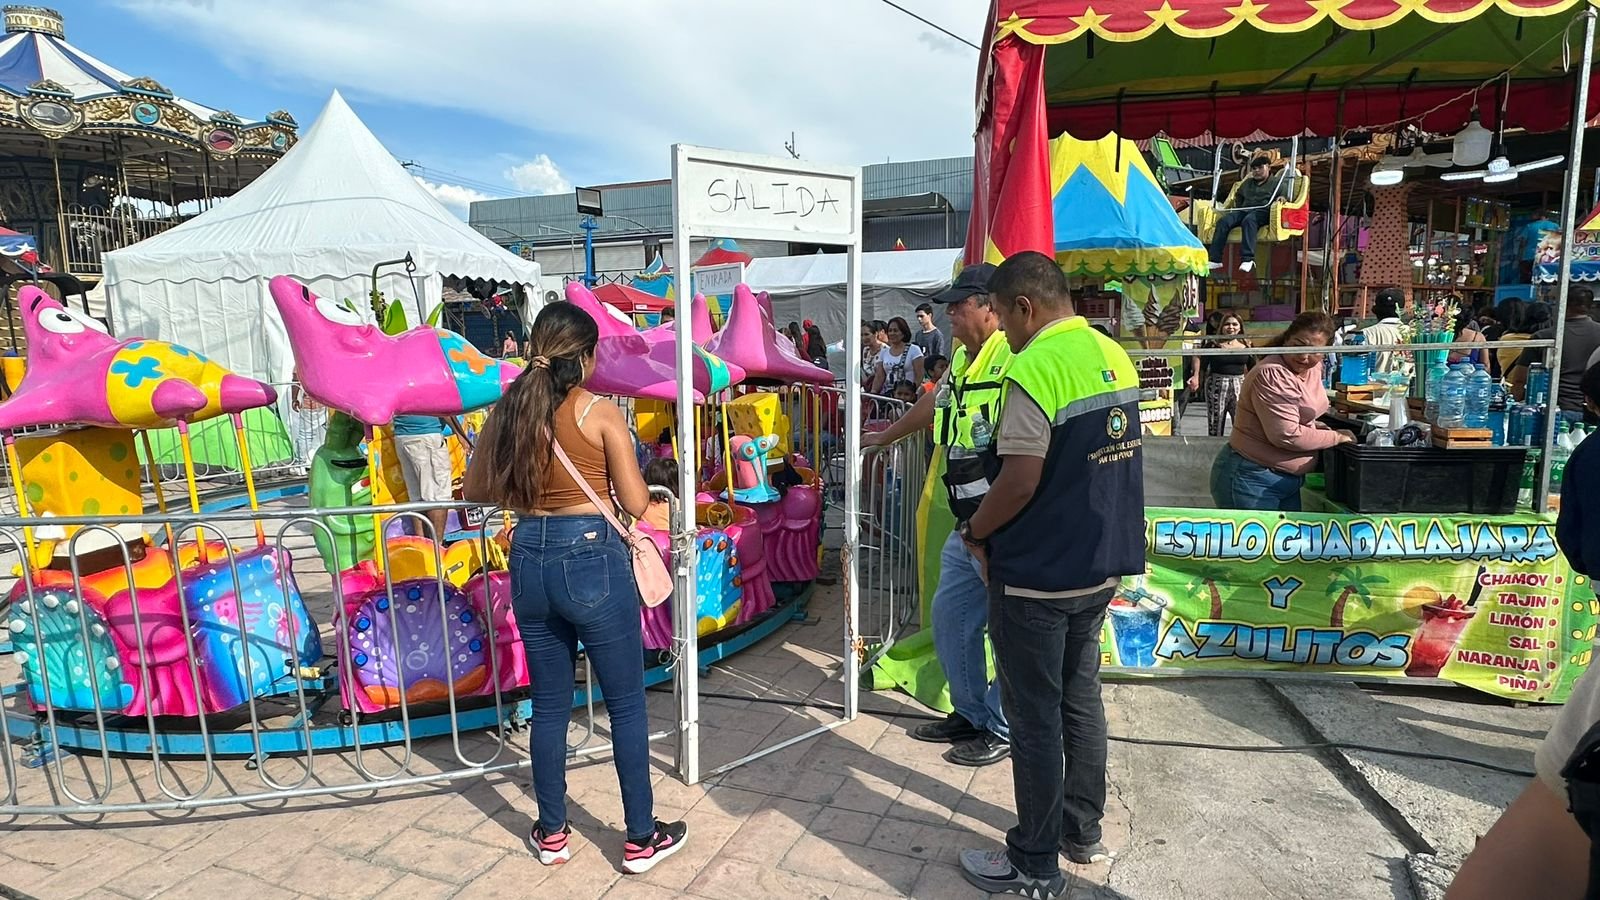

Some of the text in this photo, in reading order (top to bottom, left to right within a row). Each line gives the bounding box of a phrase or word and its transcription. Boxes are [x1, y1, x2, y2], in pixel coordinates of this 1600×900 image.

[708, 179, 839, 217] SALIDA
[700, 270, 733, 290] ENTRADA
[1153, 520, 1267, 561] ESTILO
[1272, 520, 1558, 562] GUADALAJARA
[1480, 573, 1549, 586] CHAMOY
[1263, 576, 1303, 609] Y
[1498, 593, 1547, 608] TAJIN
[1489, 612, 1544, 629] LIMÓN
[1156, 618, 1412, 668] AZULITOS
[1509, 636, 1541, 650] SAL
[1457, 650, 1540, 672] NARANJA
[1499, 675, 1538, 691] PIÑA
